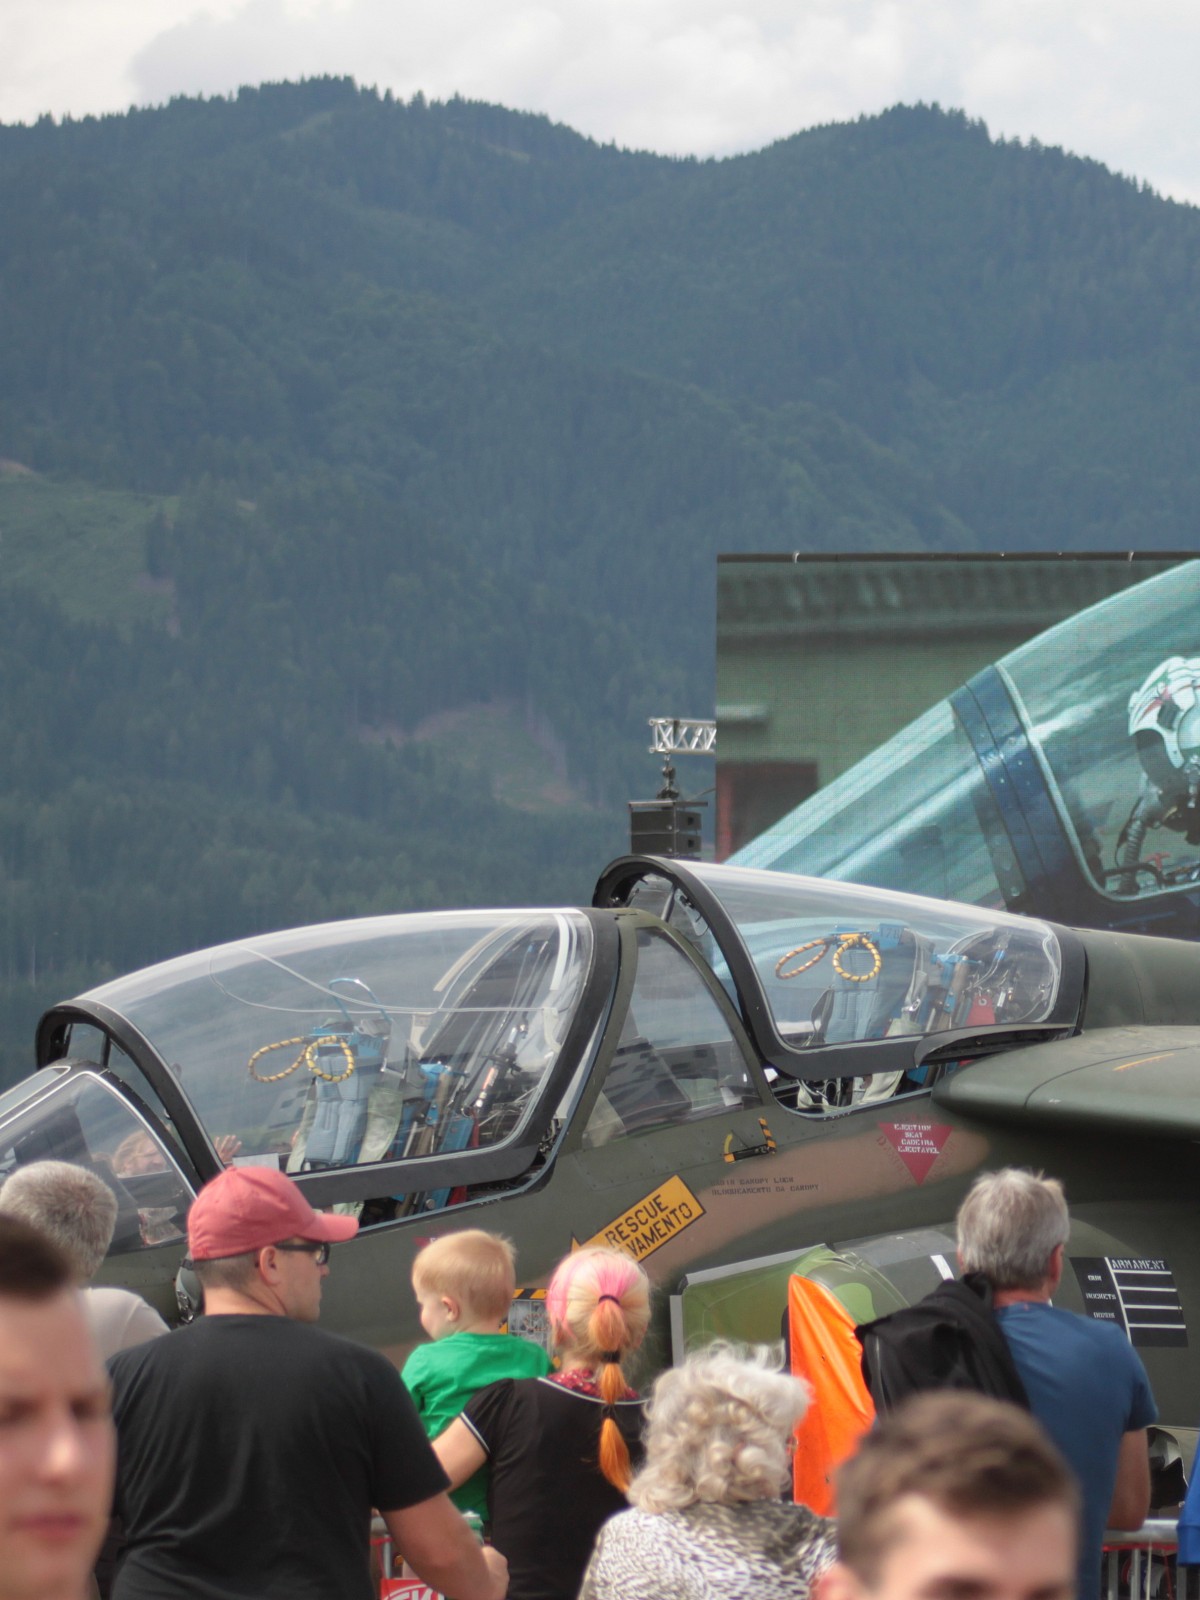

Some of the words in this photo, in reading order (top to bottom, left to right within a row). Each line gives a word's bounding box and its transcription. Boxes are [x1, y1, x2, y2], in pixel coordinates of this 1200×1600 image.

[894, 1123, 932, 1131] EJECTION
[604, 1194, 669, 1249] RESCUE
[626, 1202, 693, 1257] VAMENTO
[1111, 1259, 1165, 1270] ARMAMENT
